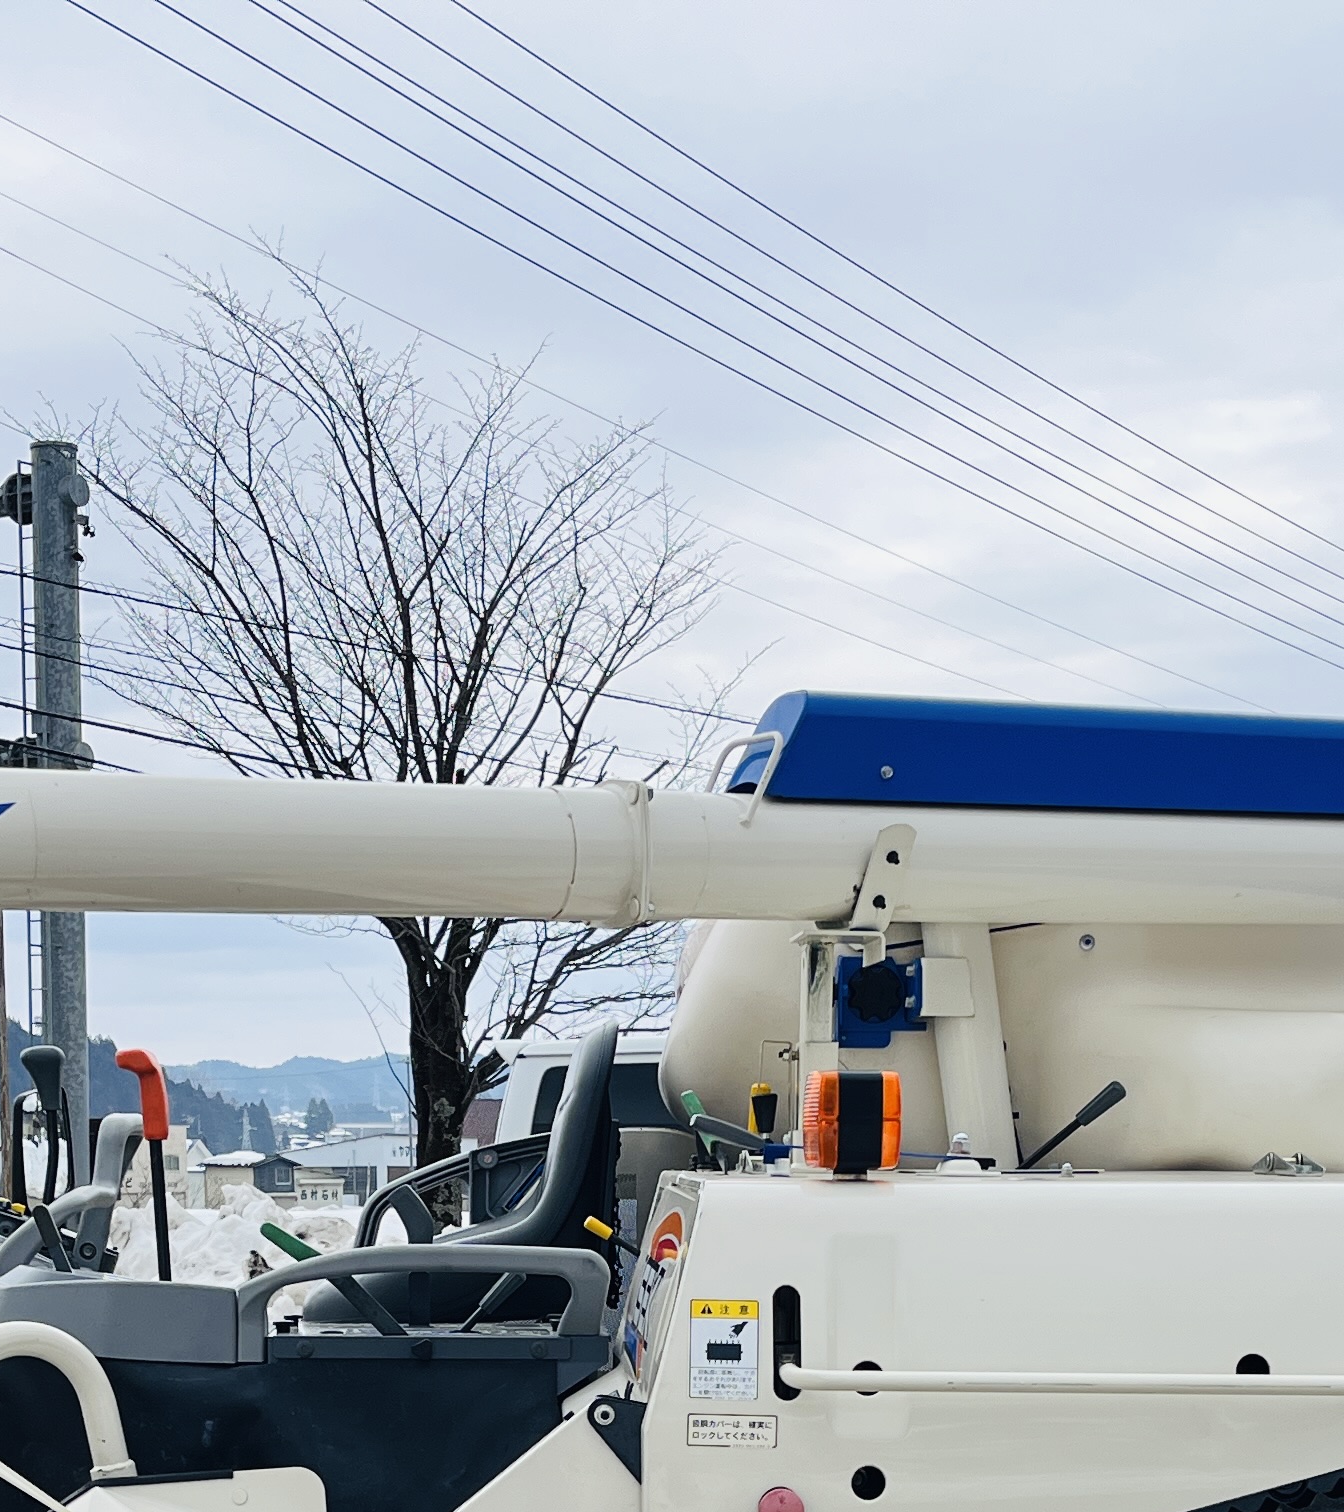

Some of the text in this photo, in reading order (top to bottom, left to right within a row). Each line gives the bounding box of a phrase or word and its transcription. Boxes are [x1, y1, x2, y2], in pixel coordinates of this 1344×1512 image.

[719, 1303, 750, 1315] 注意
[692, 1431, 769, 1441] ロックしてください。
